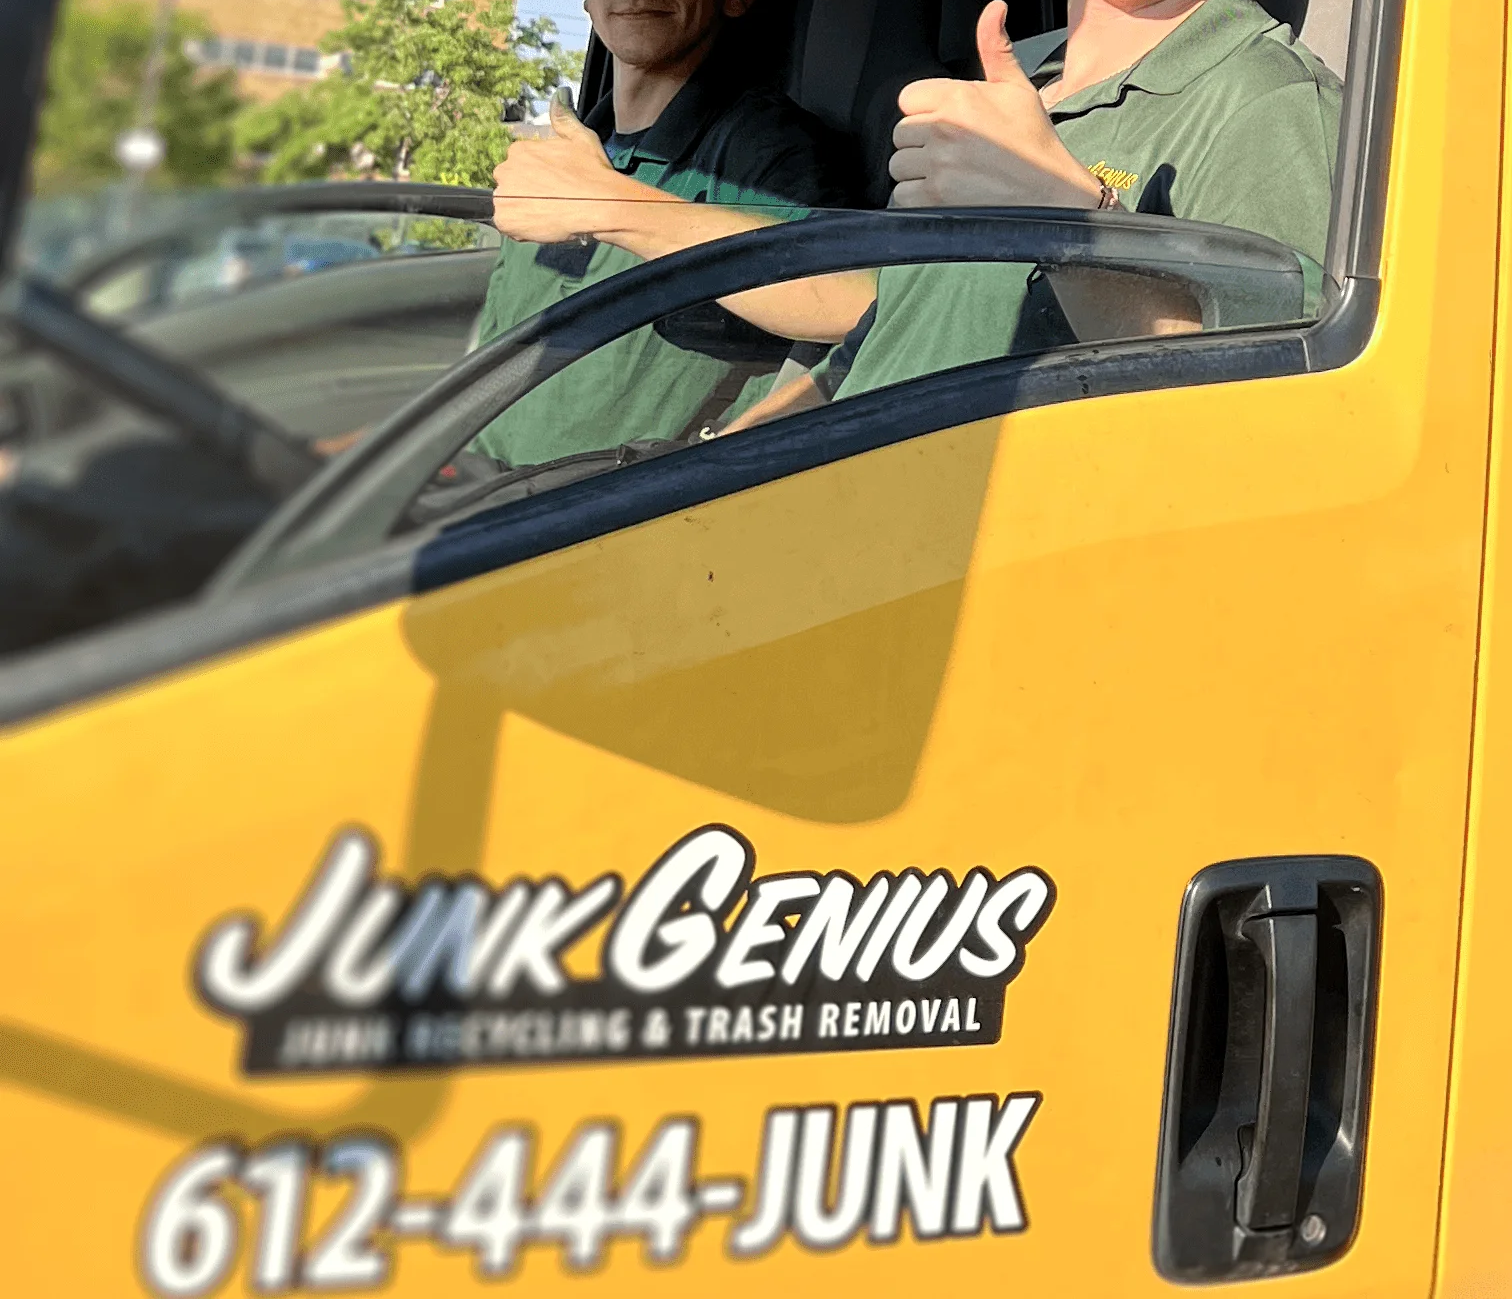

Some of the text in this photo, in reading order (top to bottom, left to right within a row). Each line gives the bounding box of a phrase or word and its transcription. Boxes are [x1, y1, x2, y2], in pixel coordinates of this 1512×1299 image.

[200, 828, 1049, 1010] JUNK GENIUS
[641, 1009, 673, 1048] &
[684, 1003, 804, 1045] TRASH
[818, 996, 982, 1038] REMOVAL
[145, 1094, 1037, 1297] 612-444-JUNK
